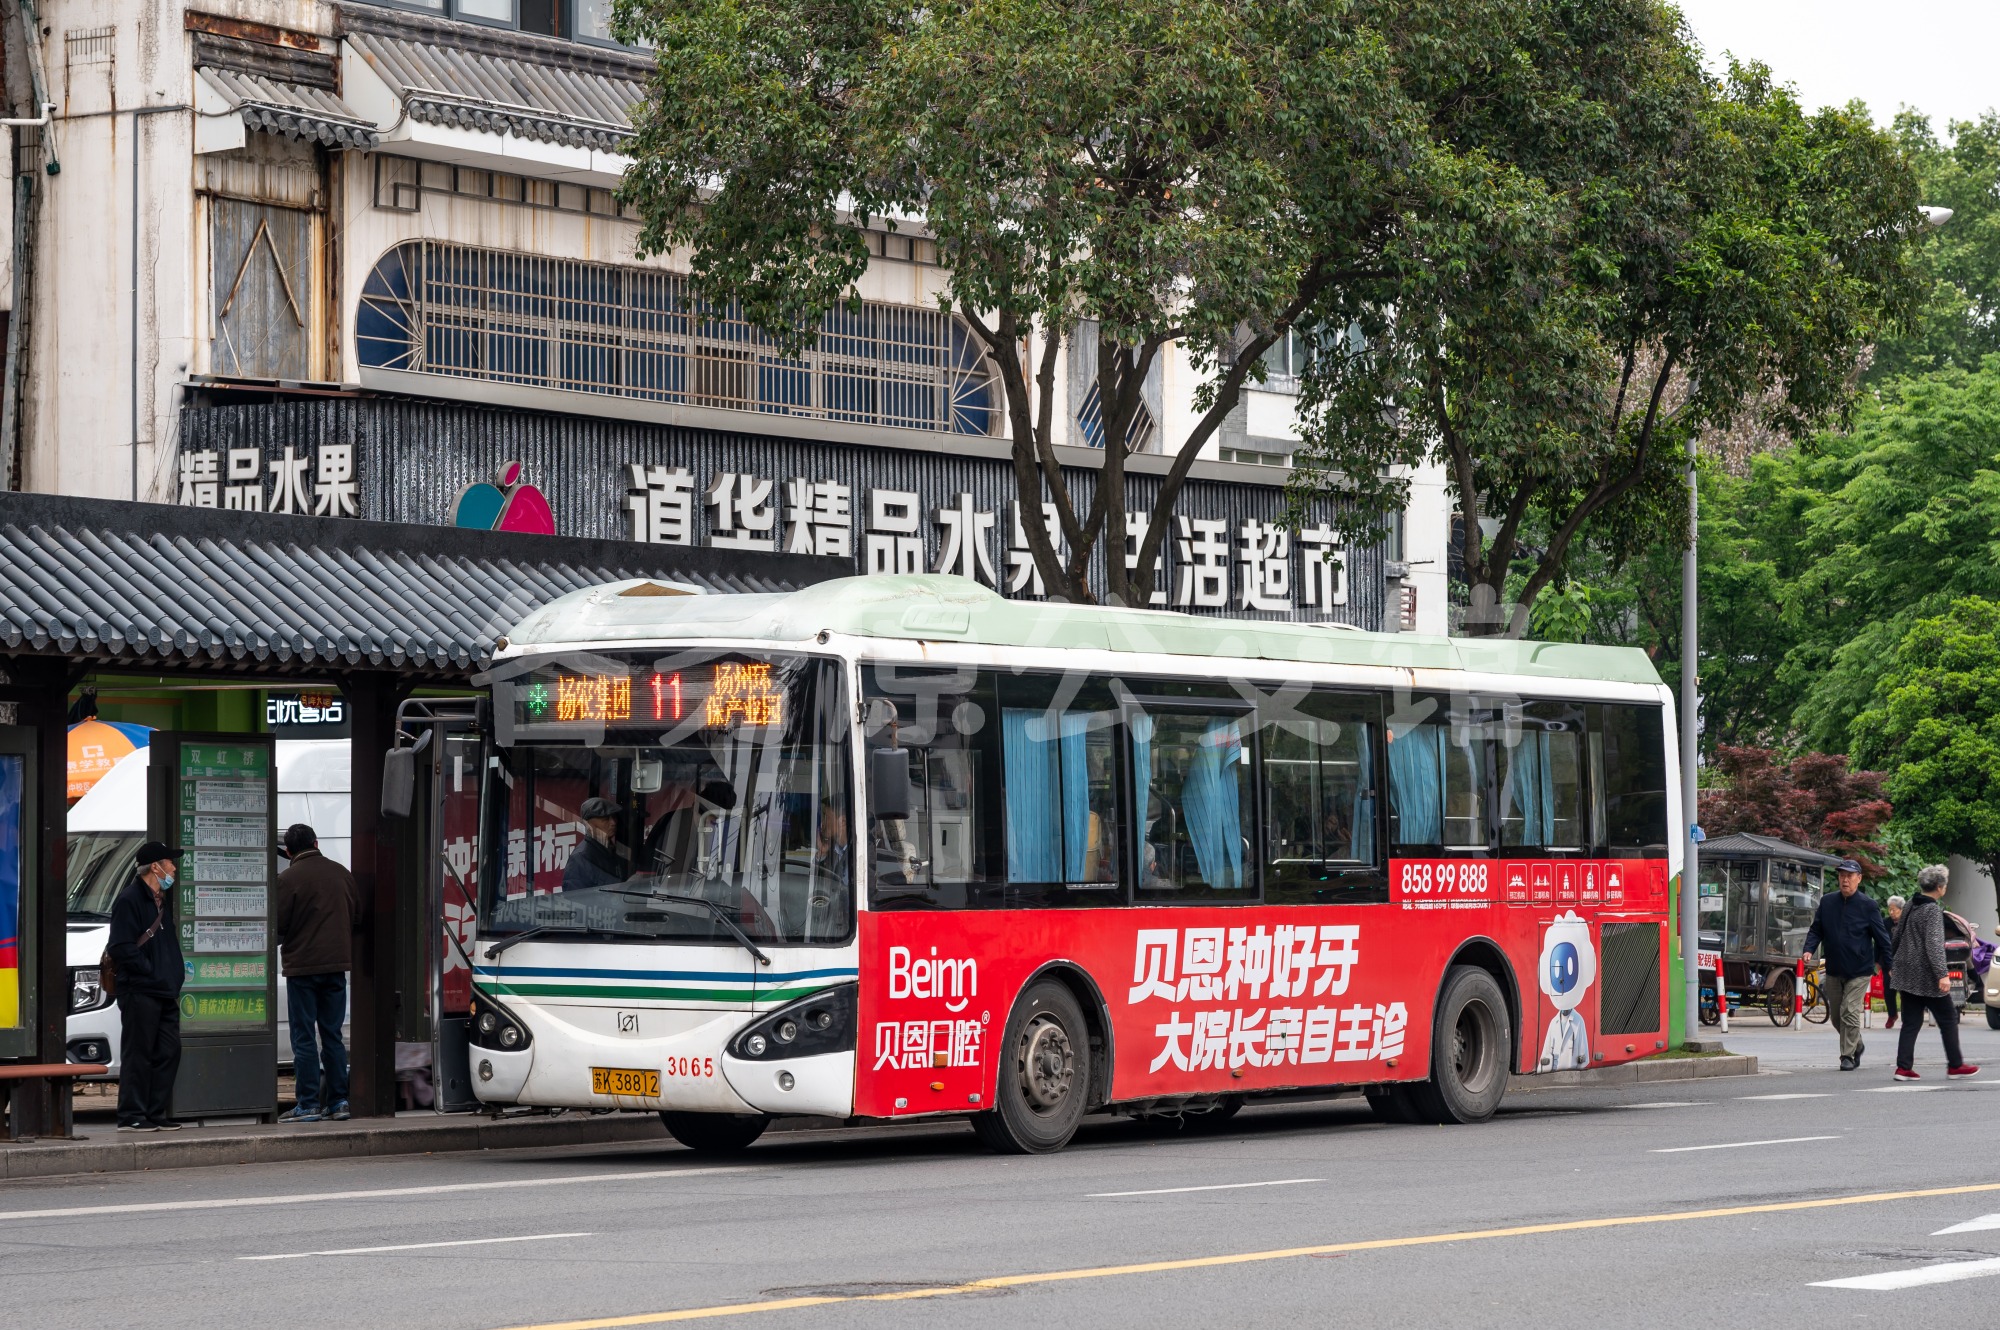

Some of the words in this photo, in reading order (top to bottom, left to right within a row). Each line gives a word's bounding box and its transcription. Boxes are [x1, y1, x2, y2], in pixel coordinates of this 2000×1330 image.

[180, 445, 361, 517] 精品水果
[557, 675, 631, 720] 扬农集团
[651, 673, 681, 719] 11
[191, 750, 254, 766] 双虹桥
[1402, 864, 1432, 893] 858
[1436, 864, 1456, 893] 99
[1459, 864, 1488, 893] 888
[889, 946, 977, 999] Beinn
[1128, 924, 1360, 1004] 贝恩种好牙
[199, 998, 265, 1015] 请依次排队上车
[872, 1019, 981, 1071] 贝恩口腔
[1149, 1001, 1409, 1075] 大院长亲自主诊
[667, 1056, 714, 1078] 3065
